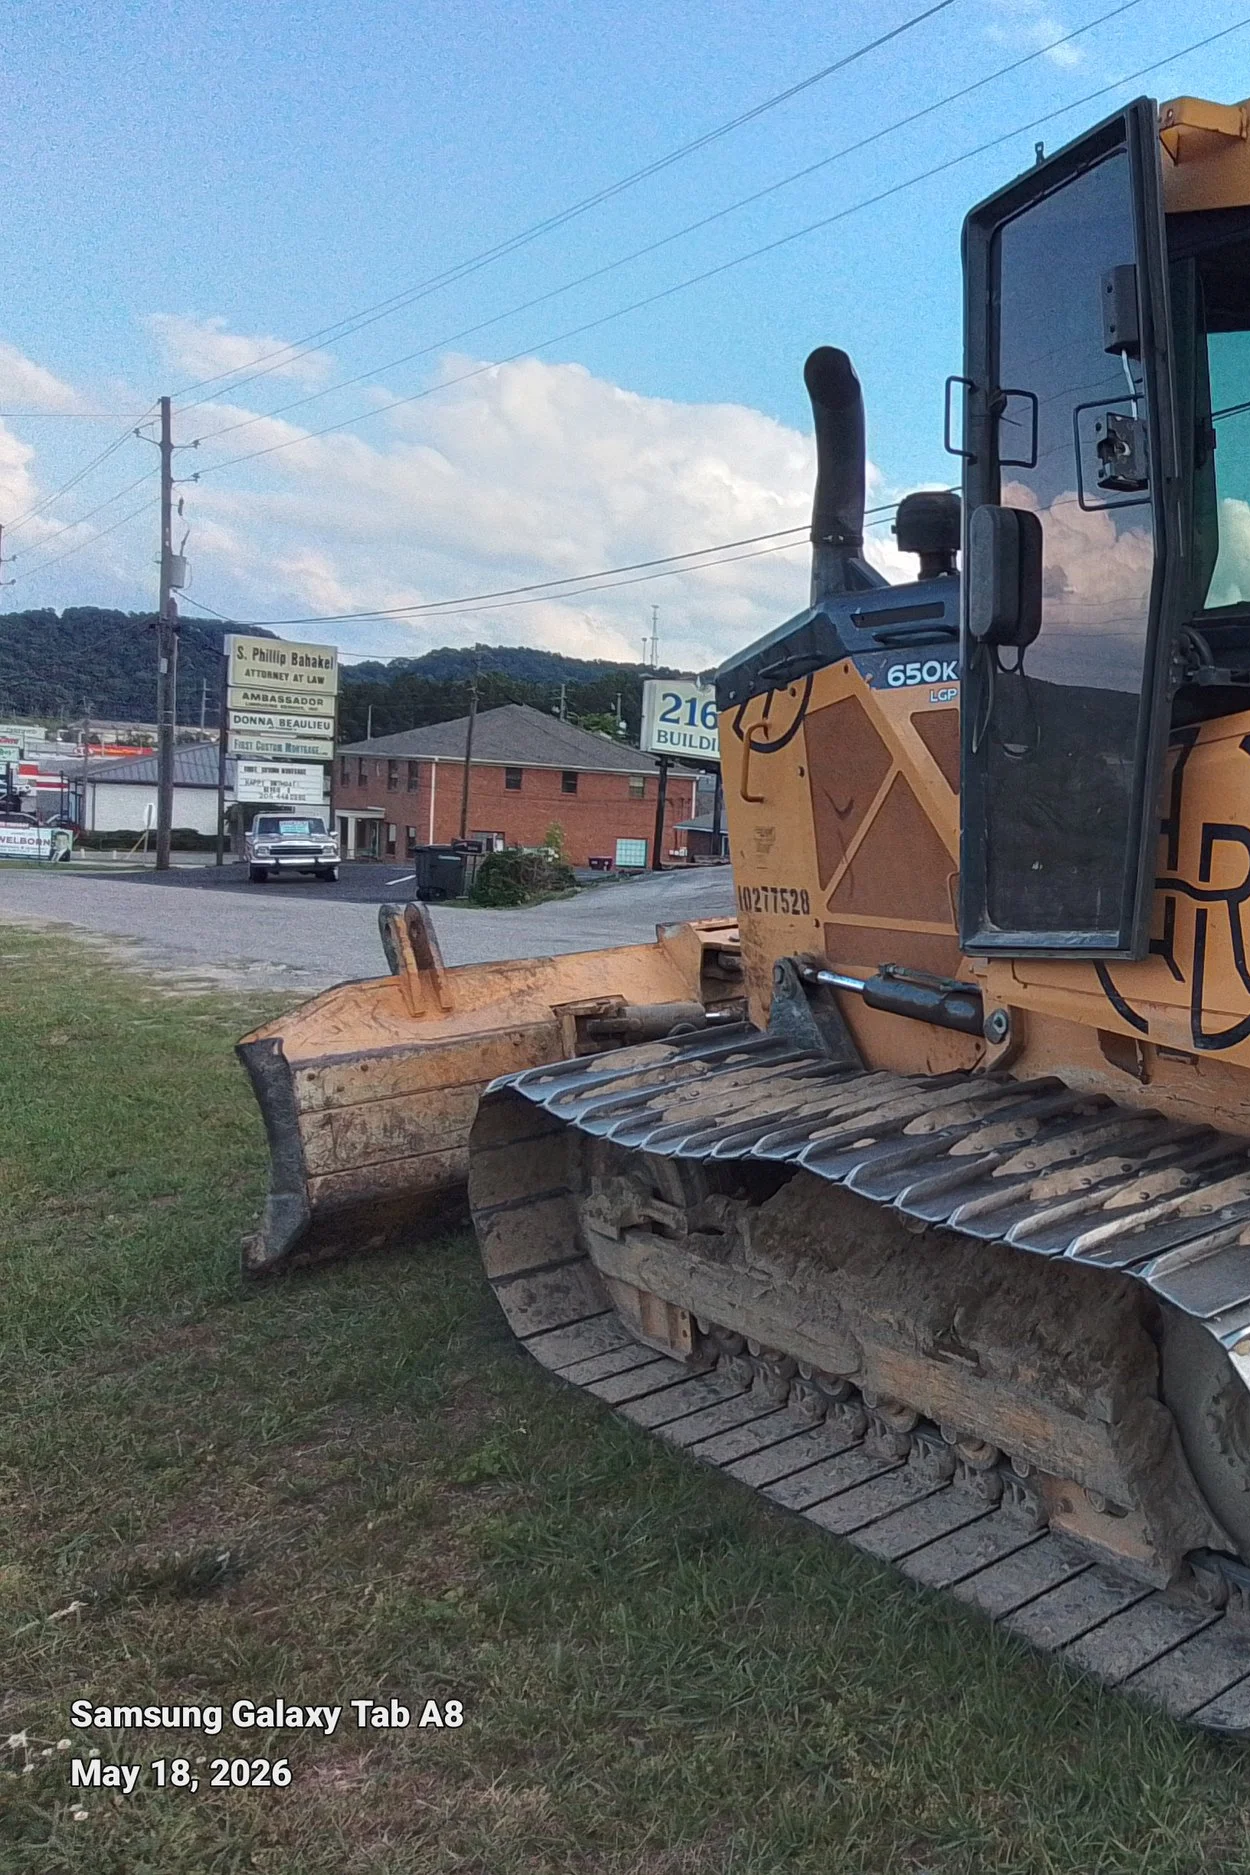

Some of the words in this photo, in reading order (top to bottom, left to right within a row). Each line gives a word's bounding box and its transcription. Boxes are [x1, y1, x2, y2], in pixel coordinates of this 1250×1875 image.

[237, 646, 247, 660] S.
[252, 647, 286, 667] Phillip
[291, 652, 334, 670] Bahakel
[244, 668, 289, 681] ATTORNEY
[293, 674, 304, 683] AT
[307, 675, 325, 684] LAW
[887, 660, 958, 687] 650K
[242, 692, 324, 706] AMBASSADOR
[930, 688, 957, 702] LGP
[658, 692, 718, 730] 216
[233, 715, 274, 727] DONNA
[279, 718, 331, 730] BEAULIEU
[233, 738, 253, 751] FIRST
[656, 729, 720, 752] BUILDI
[737, 885, 810, 915] 10277528
